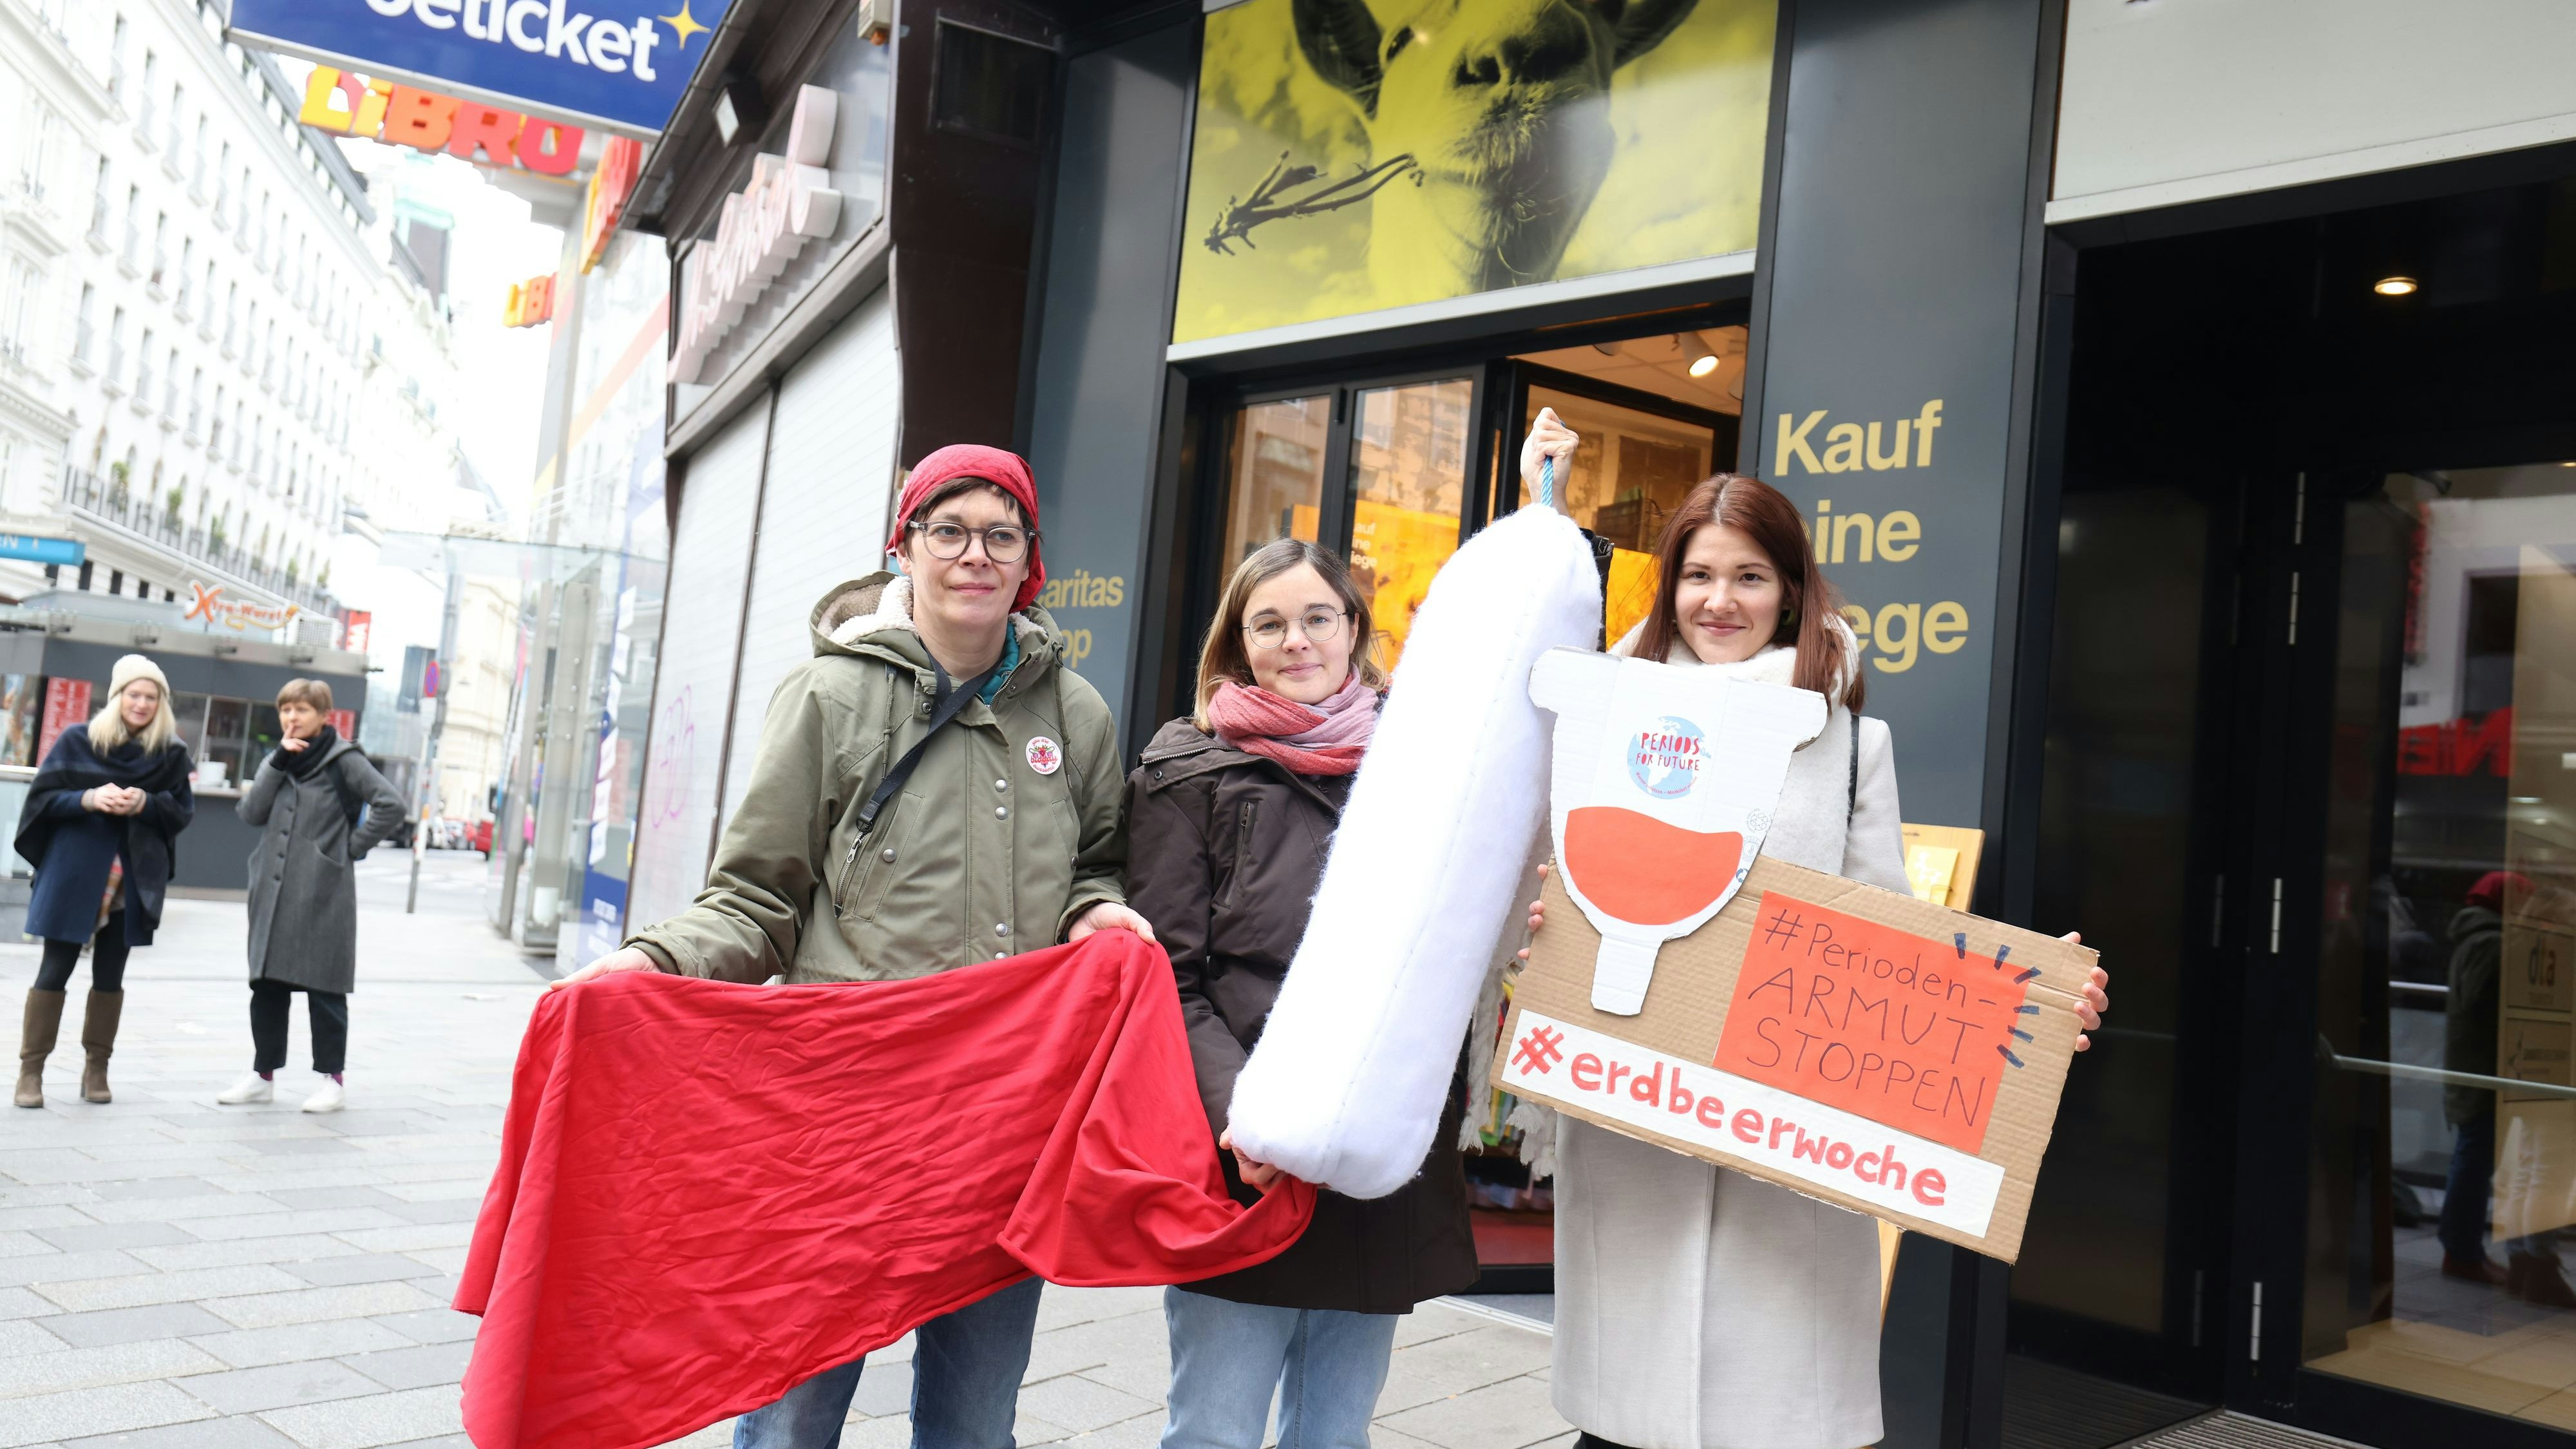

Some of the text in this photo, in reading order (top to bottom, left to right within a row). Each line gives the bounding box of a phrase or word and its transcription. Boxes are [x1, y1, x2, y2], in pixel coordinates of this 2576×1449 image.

[1774, 399, 1944, 477] Kauf
[1352, 535, 1371, 551] ine
[1354, 522, 1376, 536] auf
[1801, 499, 1922, 565] ine
[1350, 550, 1378, 571] iege
[1061, 628, 1092, 669] op
[1838, 600, 1969, 674] ege
[1031, 755, 1057, 764] bloody
[1636, 752, 1700, 771] FOR FUTURE
[1642, 732, 1700, 755] PERIODS
[1747, 967, 1984, 1065] ARMUT
[1747, 1017, 1986, 1127] STOPPEN
[1511, 1025, 1947, 1207] #erdbeerwoche
